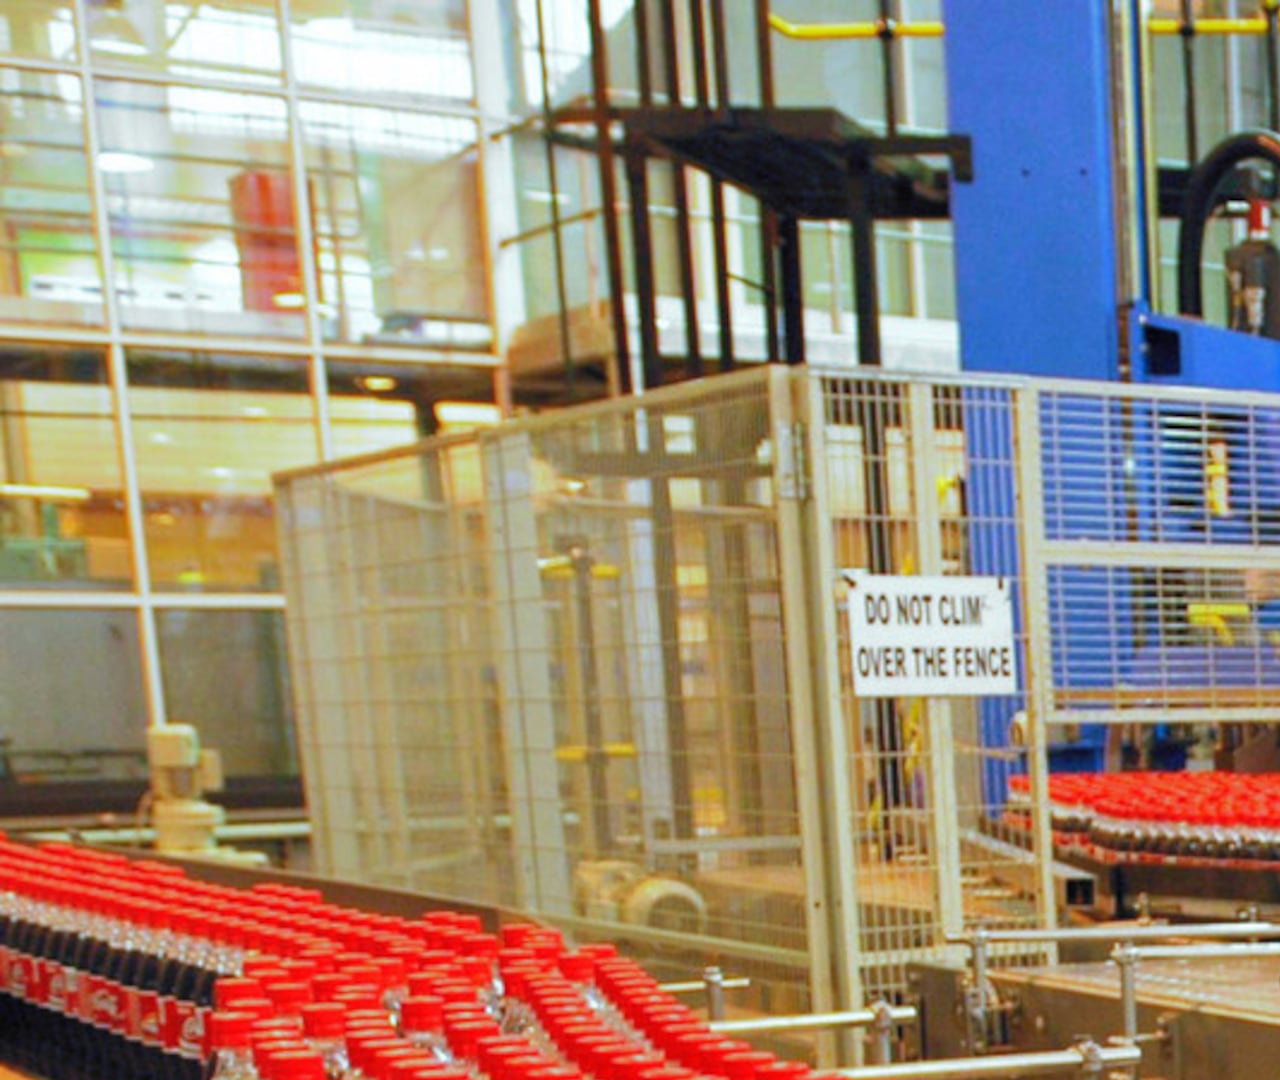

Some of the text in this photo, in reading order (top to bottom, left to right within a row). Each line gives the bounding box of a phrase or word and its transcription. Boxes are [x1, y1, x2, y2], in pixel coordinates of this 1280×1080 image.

[865, 595, 985, 625] DO NOT CLIM
[857, 647, 1011, 677] OVER THE FENCE
